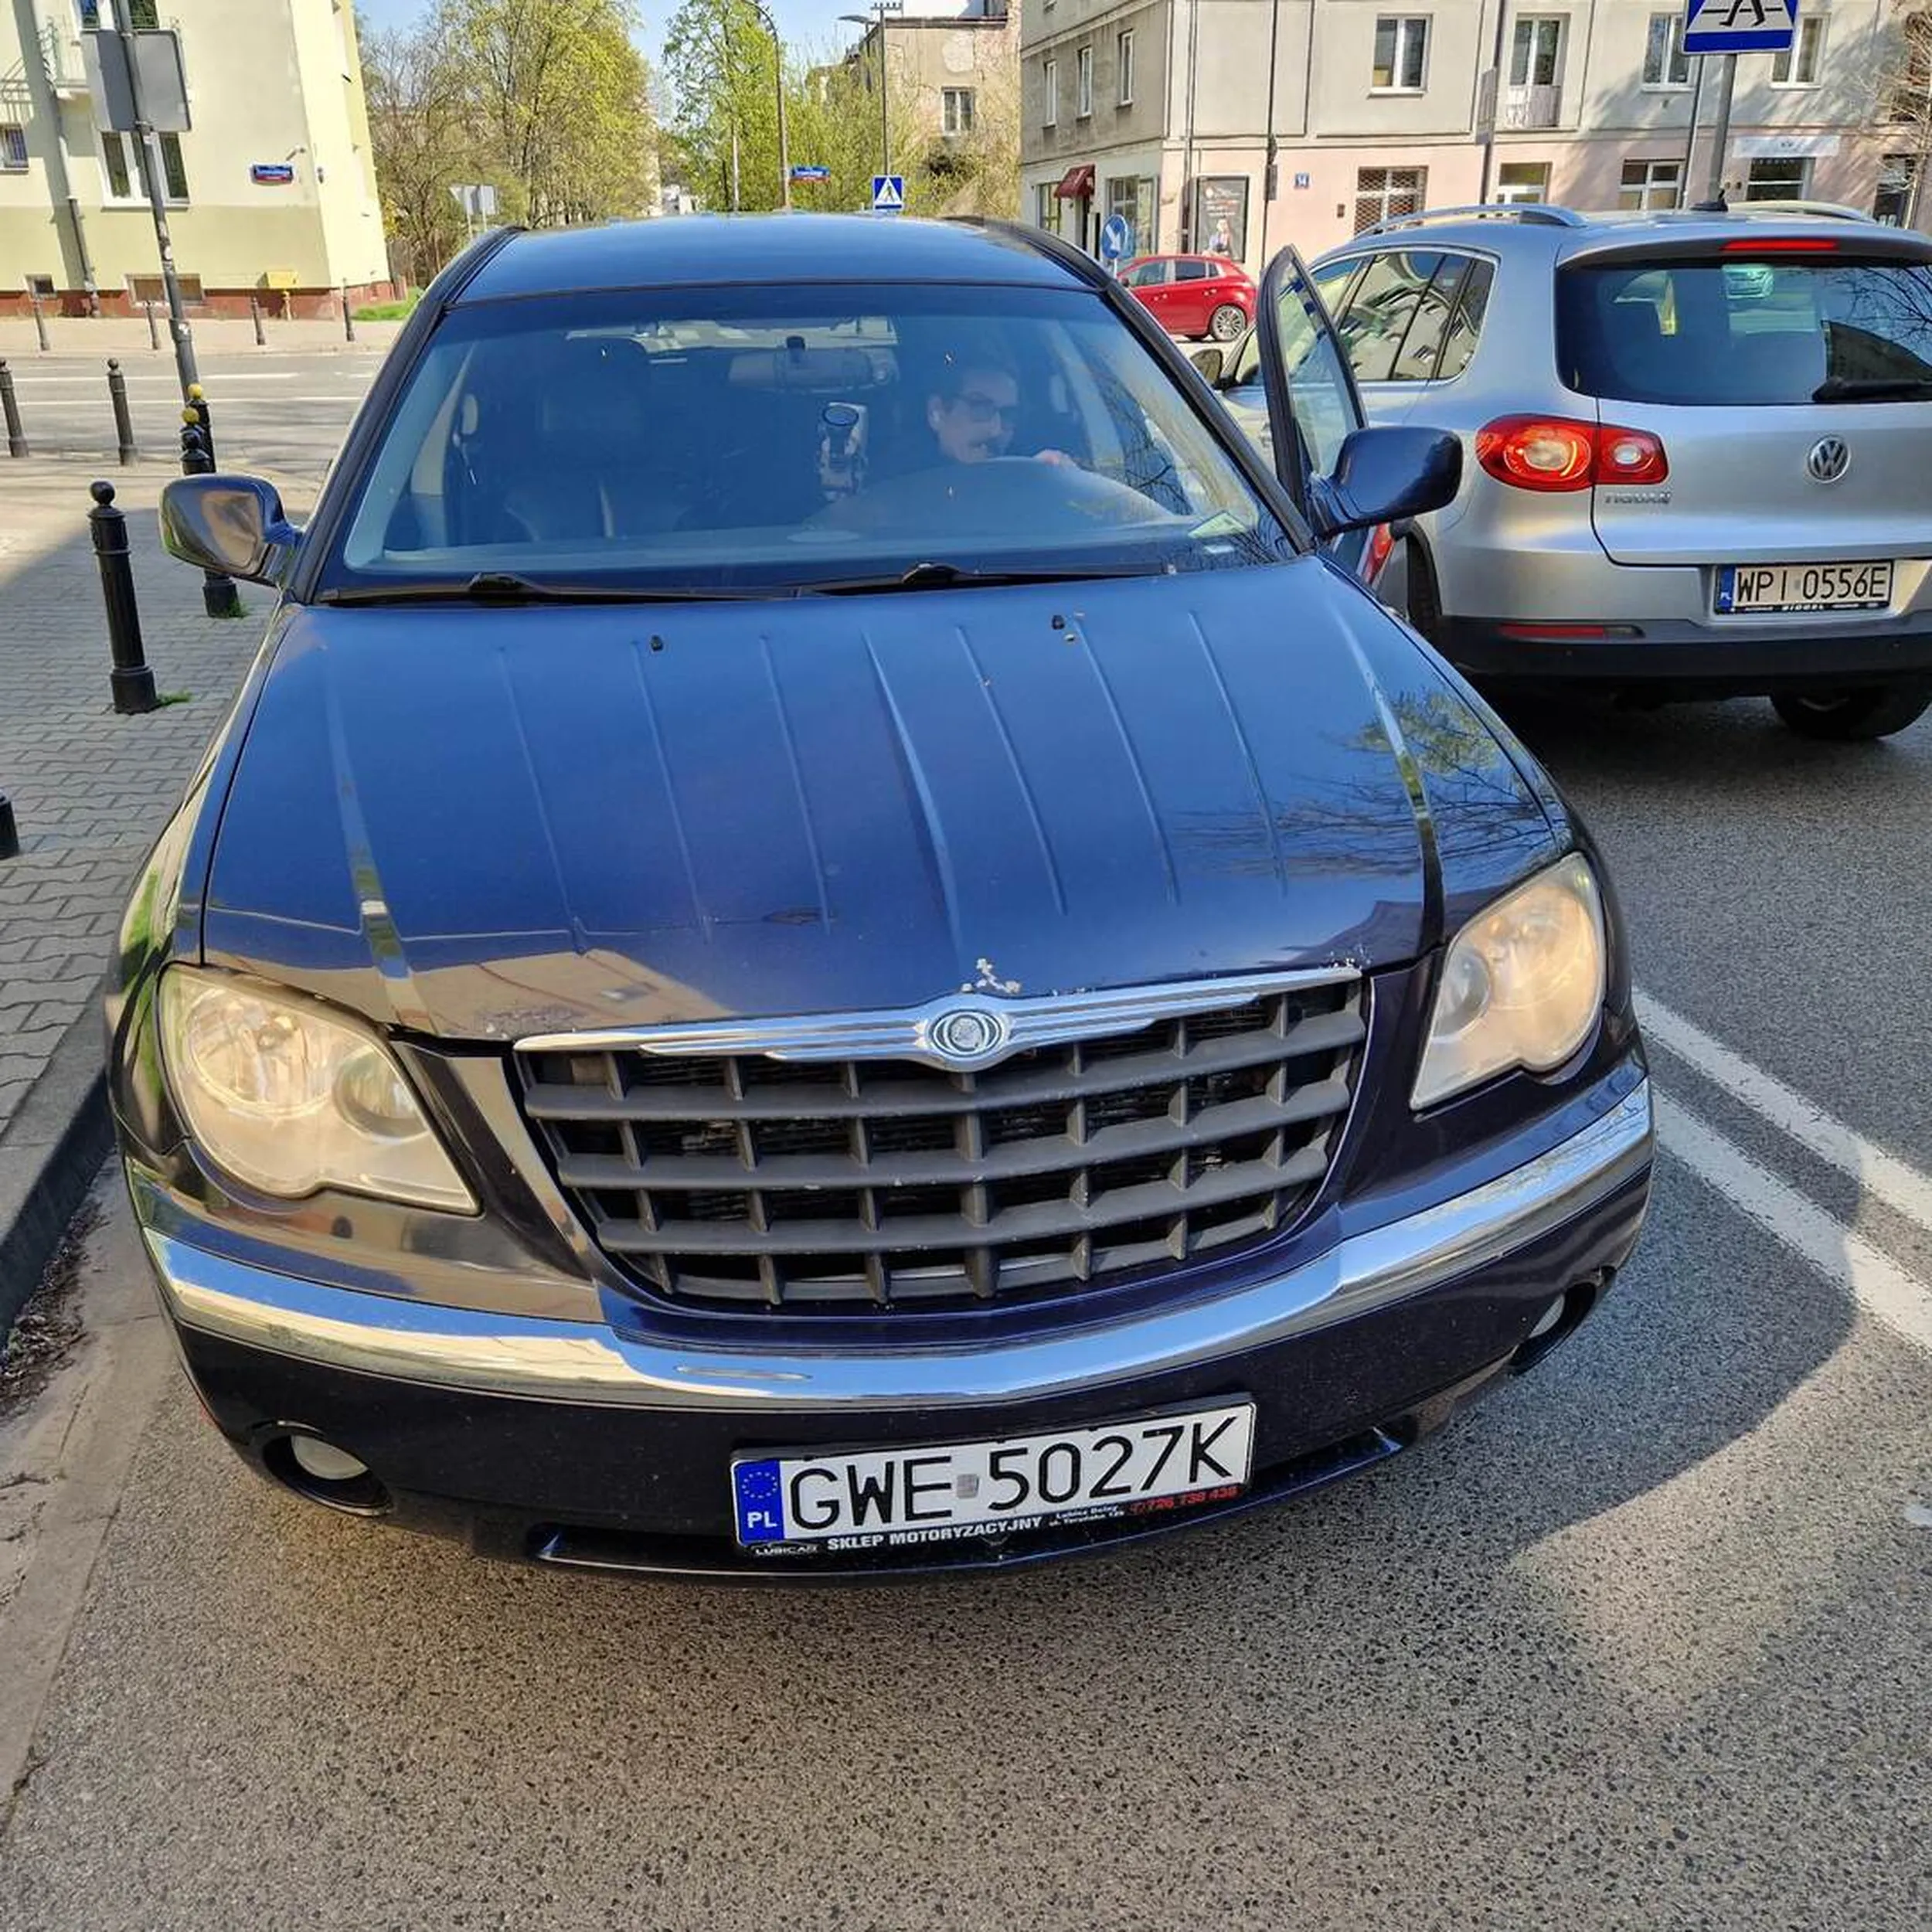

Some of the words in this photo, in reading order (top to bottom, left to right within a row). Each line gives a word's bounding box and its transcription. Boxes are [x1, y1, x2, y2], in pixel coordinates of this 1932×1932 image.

[1738, 570, 1787, 601] WPI
[1803, 566, 1887, 600] 0556E
[790, 1455, 952, 1530] GWE
[988, 1416, 1237, 1512] 5027K
[747, 1511, 777, 1529] PL
[827, 1535, 884, 1551] SKLEP
[889, 1515, 1043, 1546] MOTORYZACYJNY
